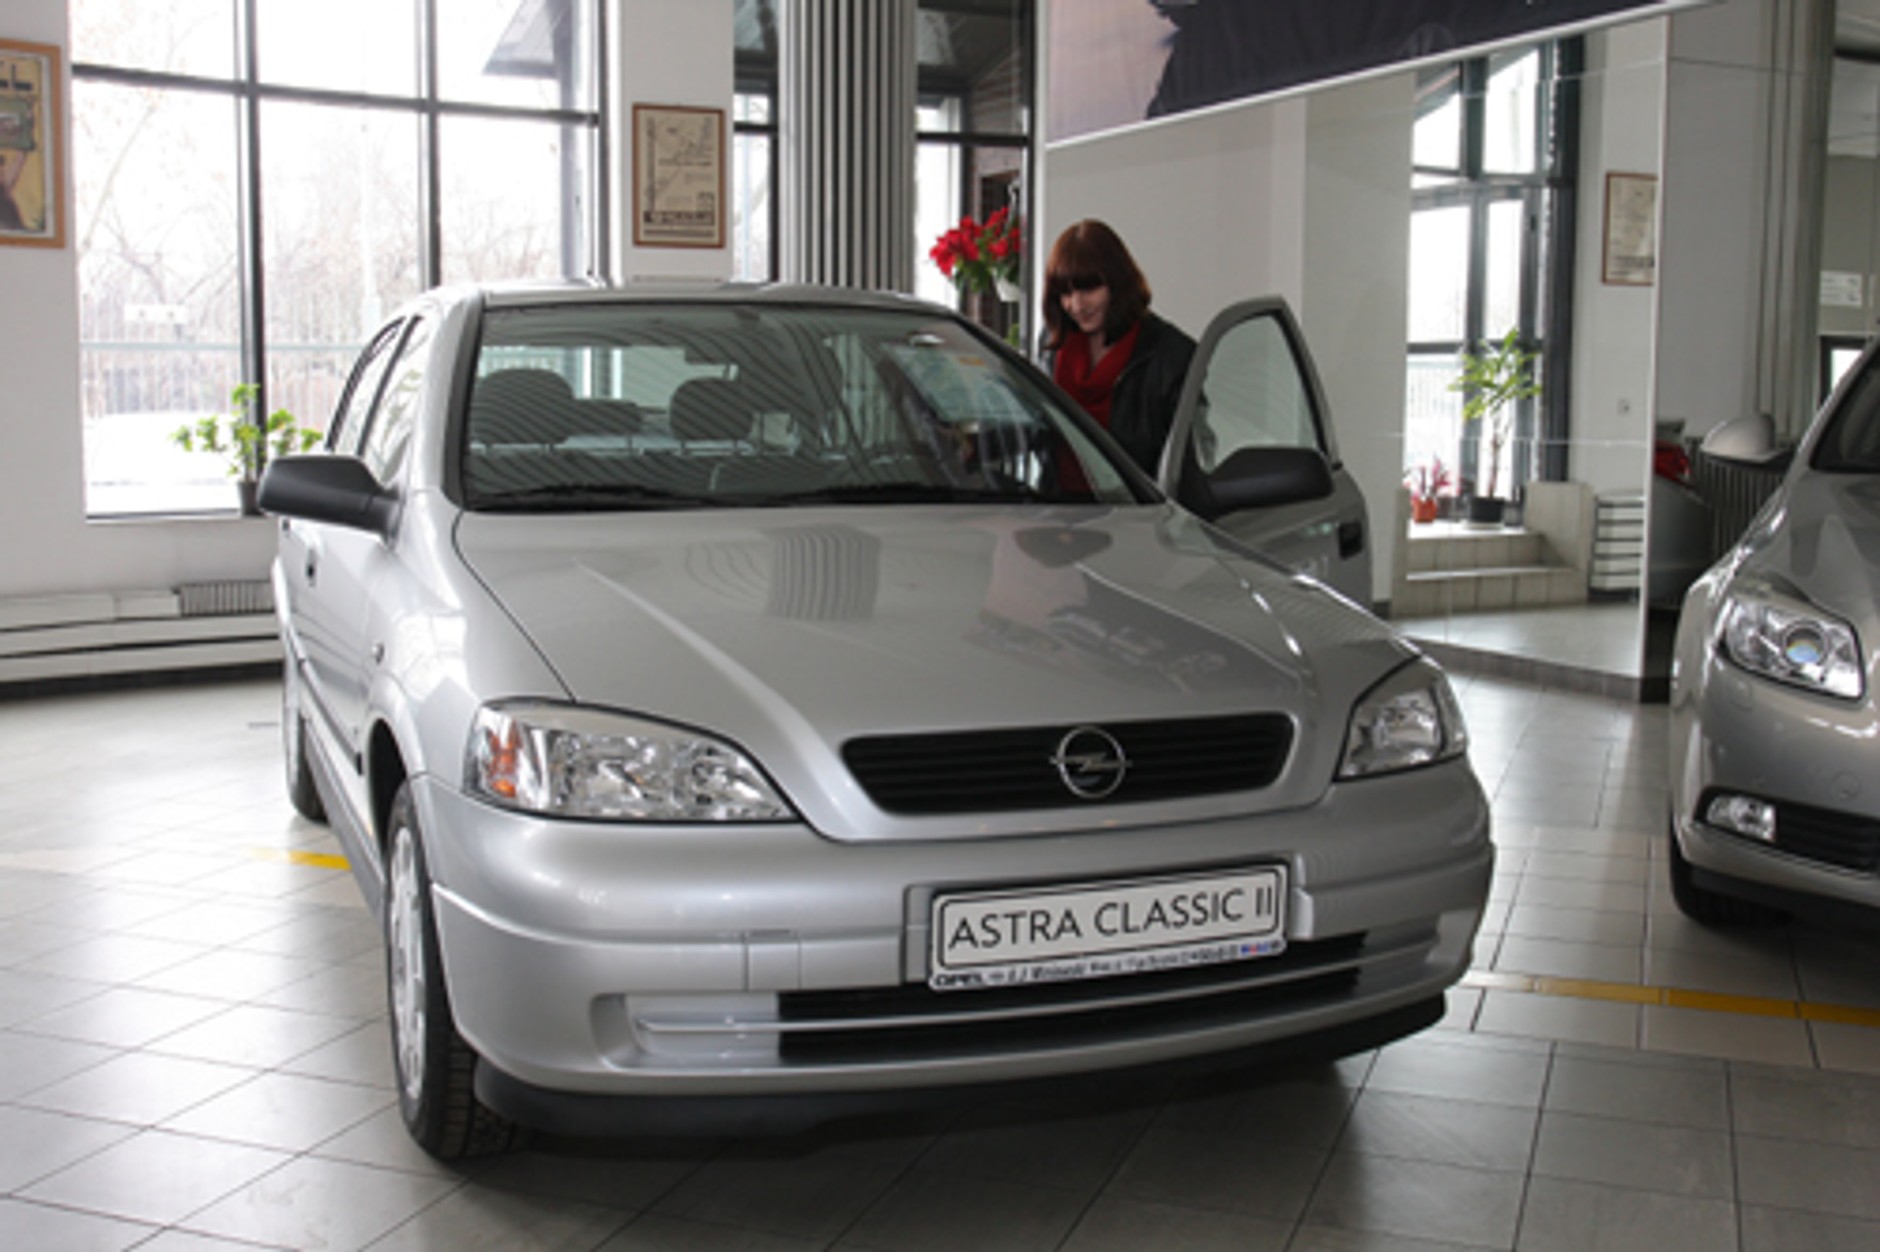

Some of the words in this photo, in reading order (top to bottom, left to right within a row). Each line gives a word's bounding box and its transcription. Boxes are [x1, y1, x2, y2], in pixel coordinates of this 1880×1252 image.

[948, 908, 1083, 950] ASTRA
[1094, 888, 1245, 937] CLASSIC
[1255, 885, 1272, 918] II
